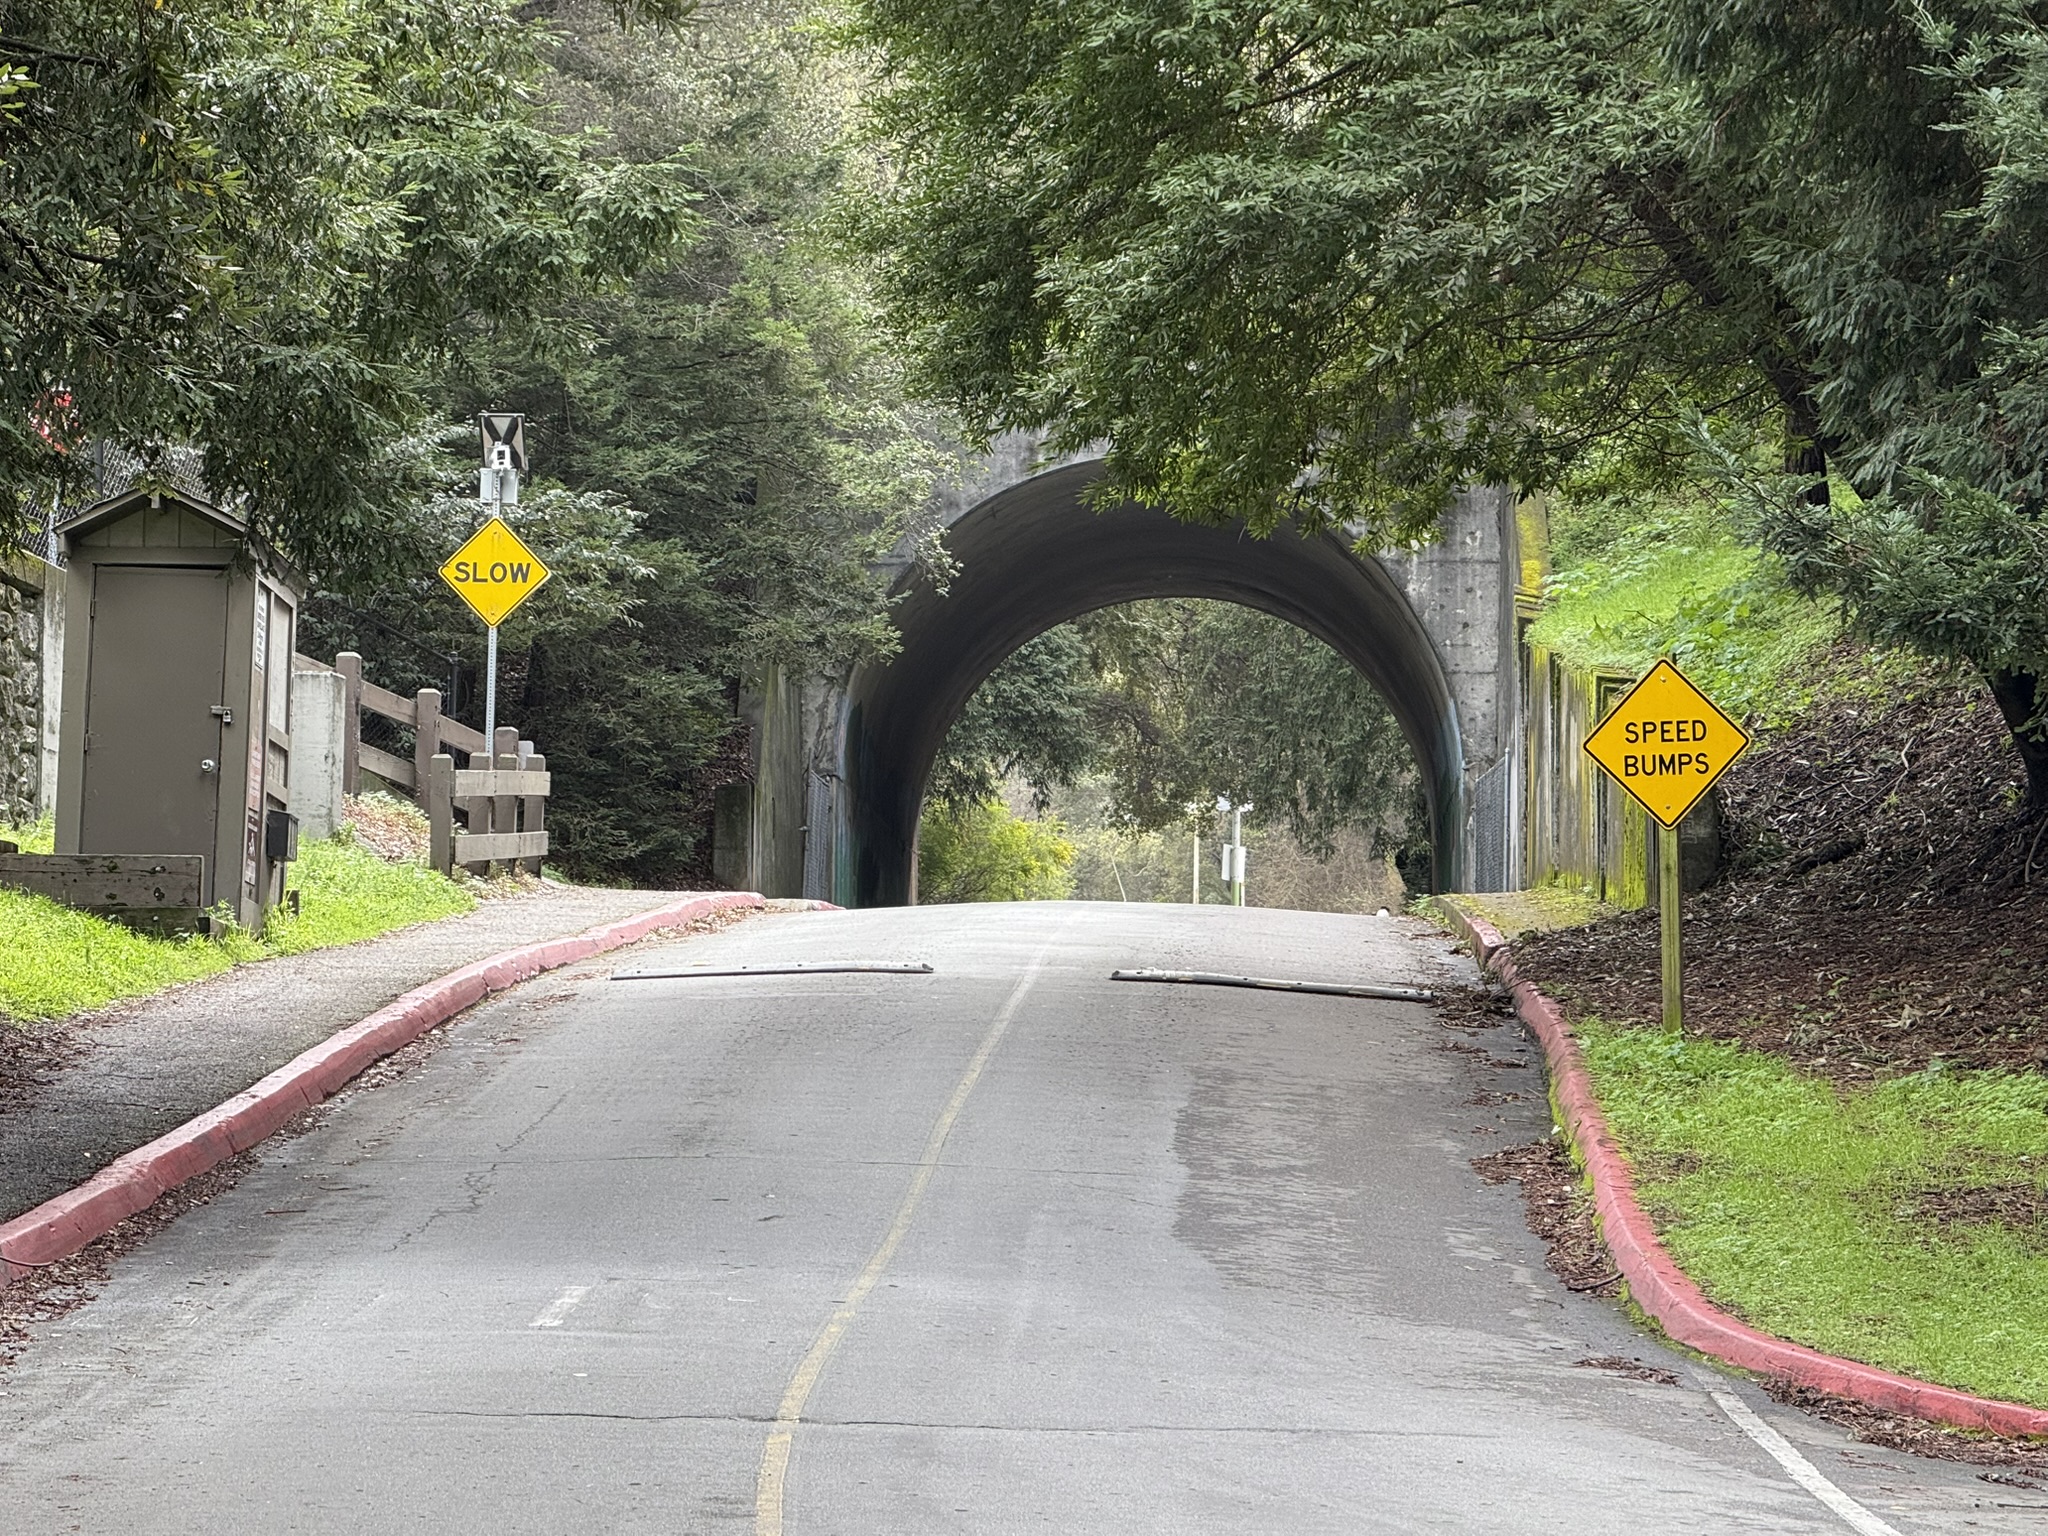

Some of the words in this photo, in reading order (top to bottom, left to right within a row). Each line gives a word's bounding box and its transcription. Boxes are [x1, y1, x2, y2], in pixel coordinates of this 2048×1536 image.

[453, 561, 531, 584] SLOW
[1624, 719, 1708, 744] SPEED
[1623, 752, 1710, 777] BUMPS
